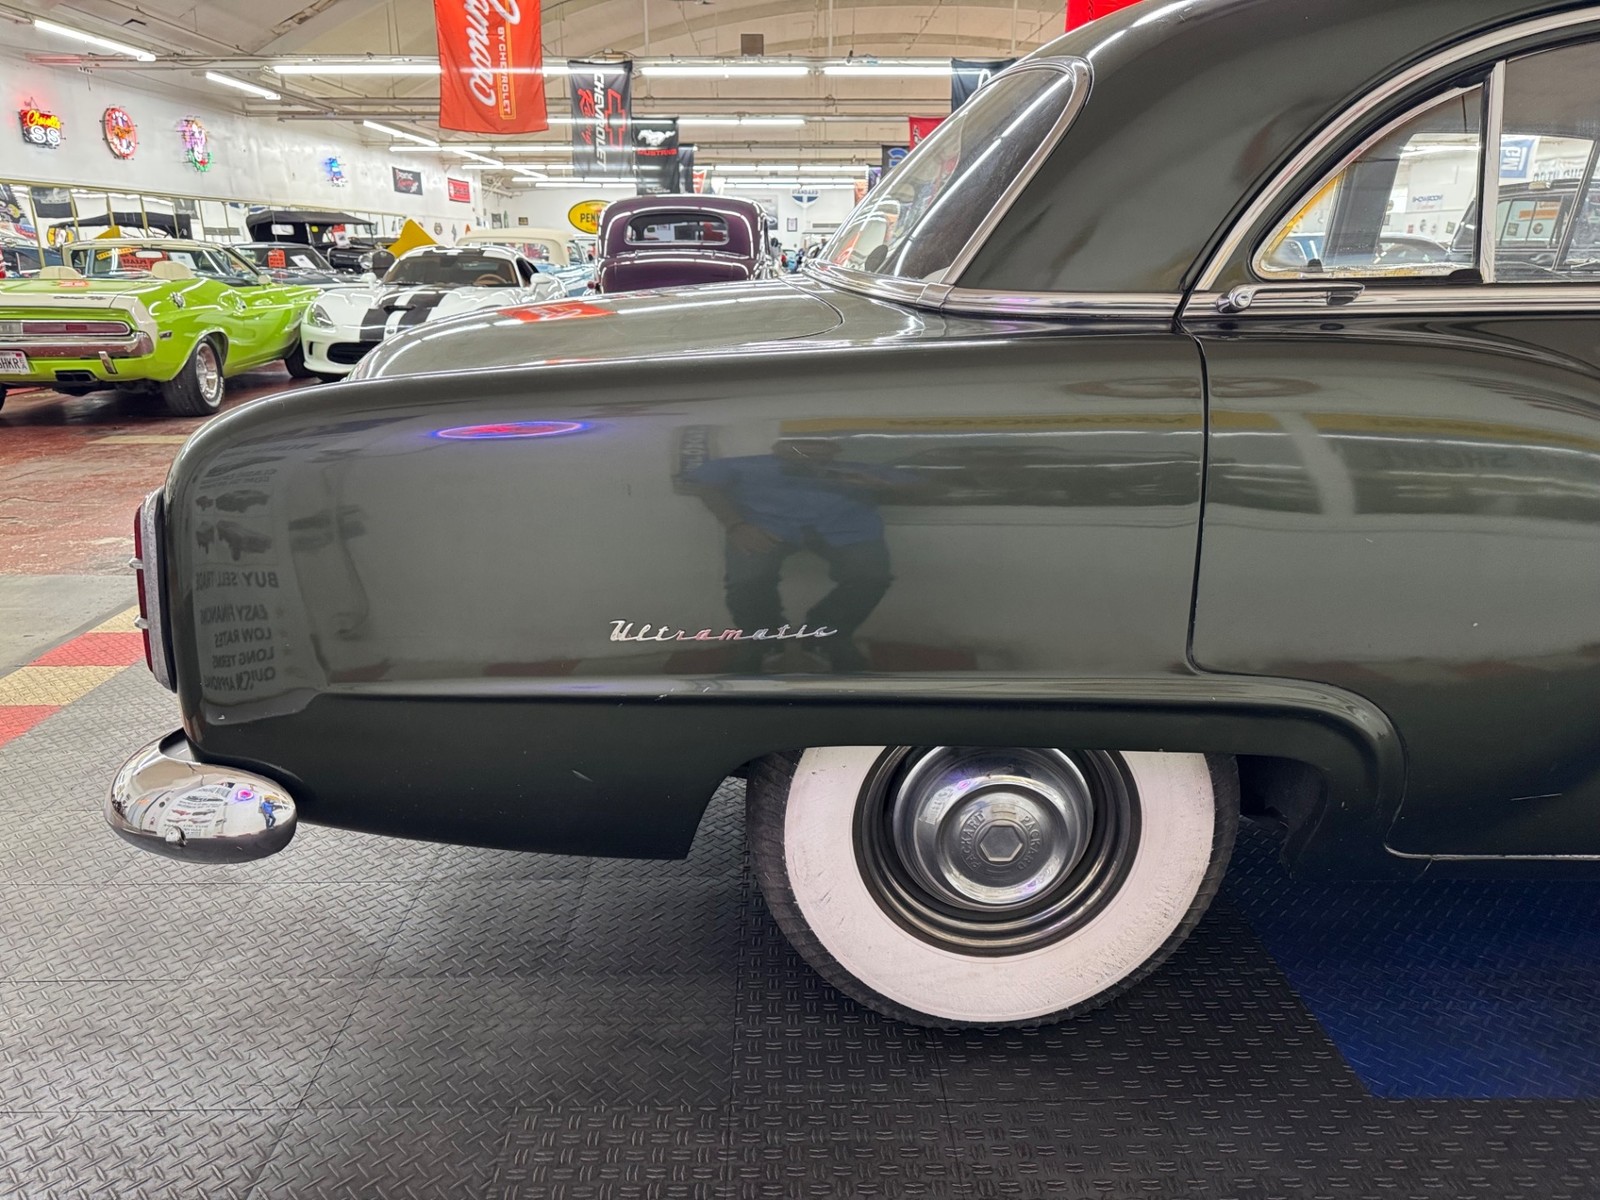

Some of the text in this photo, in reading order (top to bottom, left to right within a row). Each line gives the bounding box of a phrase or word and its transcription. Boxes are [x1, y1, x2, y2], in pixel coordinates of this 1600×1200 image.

[498, 26, 511, 114] BY CHEVROLET
[29, 125, 61, 145] SS
[593, 72, 607, 172] CHEVROLET
[637, 148, 678, 156] MUSTANG
[609, 619, 838, 642] Ultramatic
[961, 810, 986, 868] PACKARD
[1020, 815, 1041, 870] PACKARD
